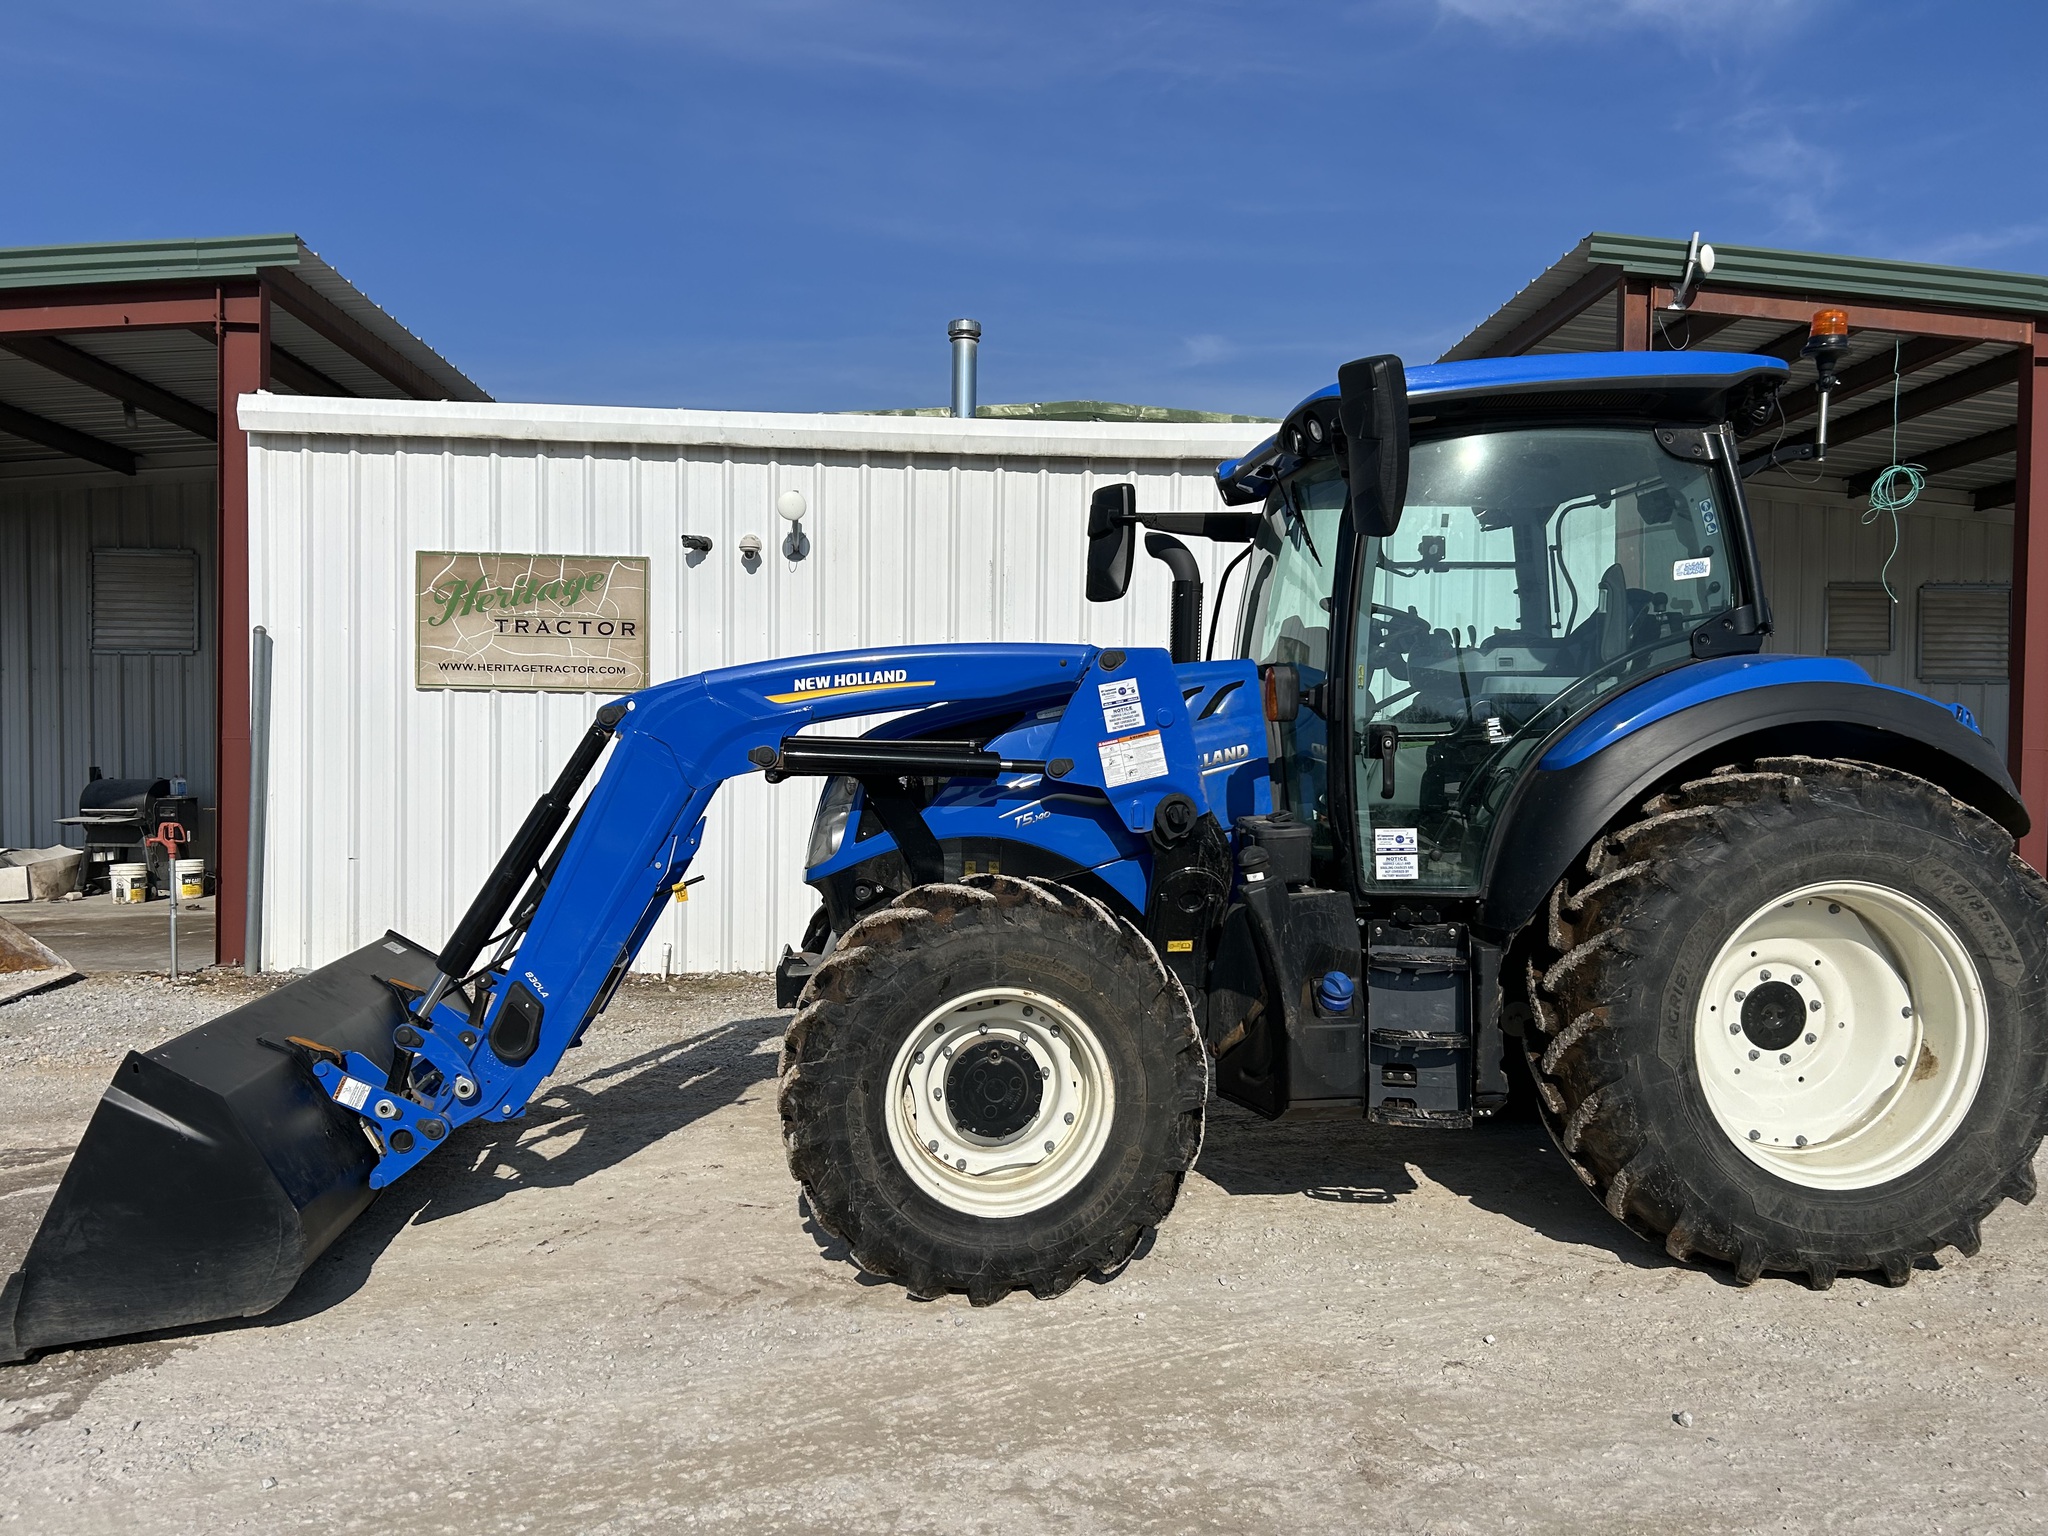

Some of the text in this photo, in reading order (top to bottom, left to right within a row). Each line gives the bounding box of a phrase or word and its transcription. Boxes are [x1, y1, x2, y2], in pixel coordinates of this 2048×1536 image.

[428, 572, 607, 627] Heritage
[494, 618, 636, 636] TRACTOR
[438, 662, 626, 675] WWW.HERITAGETRACTOR.COM
[794, 669, 907, 692] NEW HOLLAND
